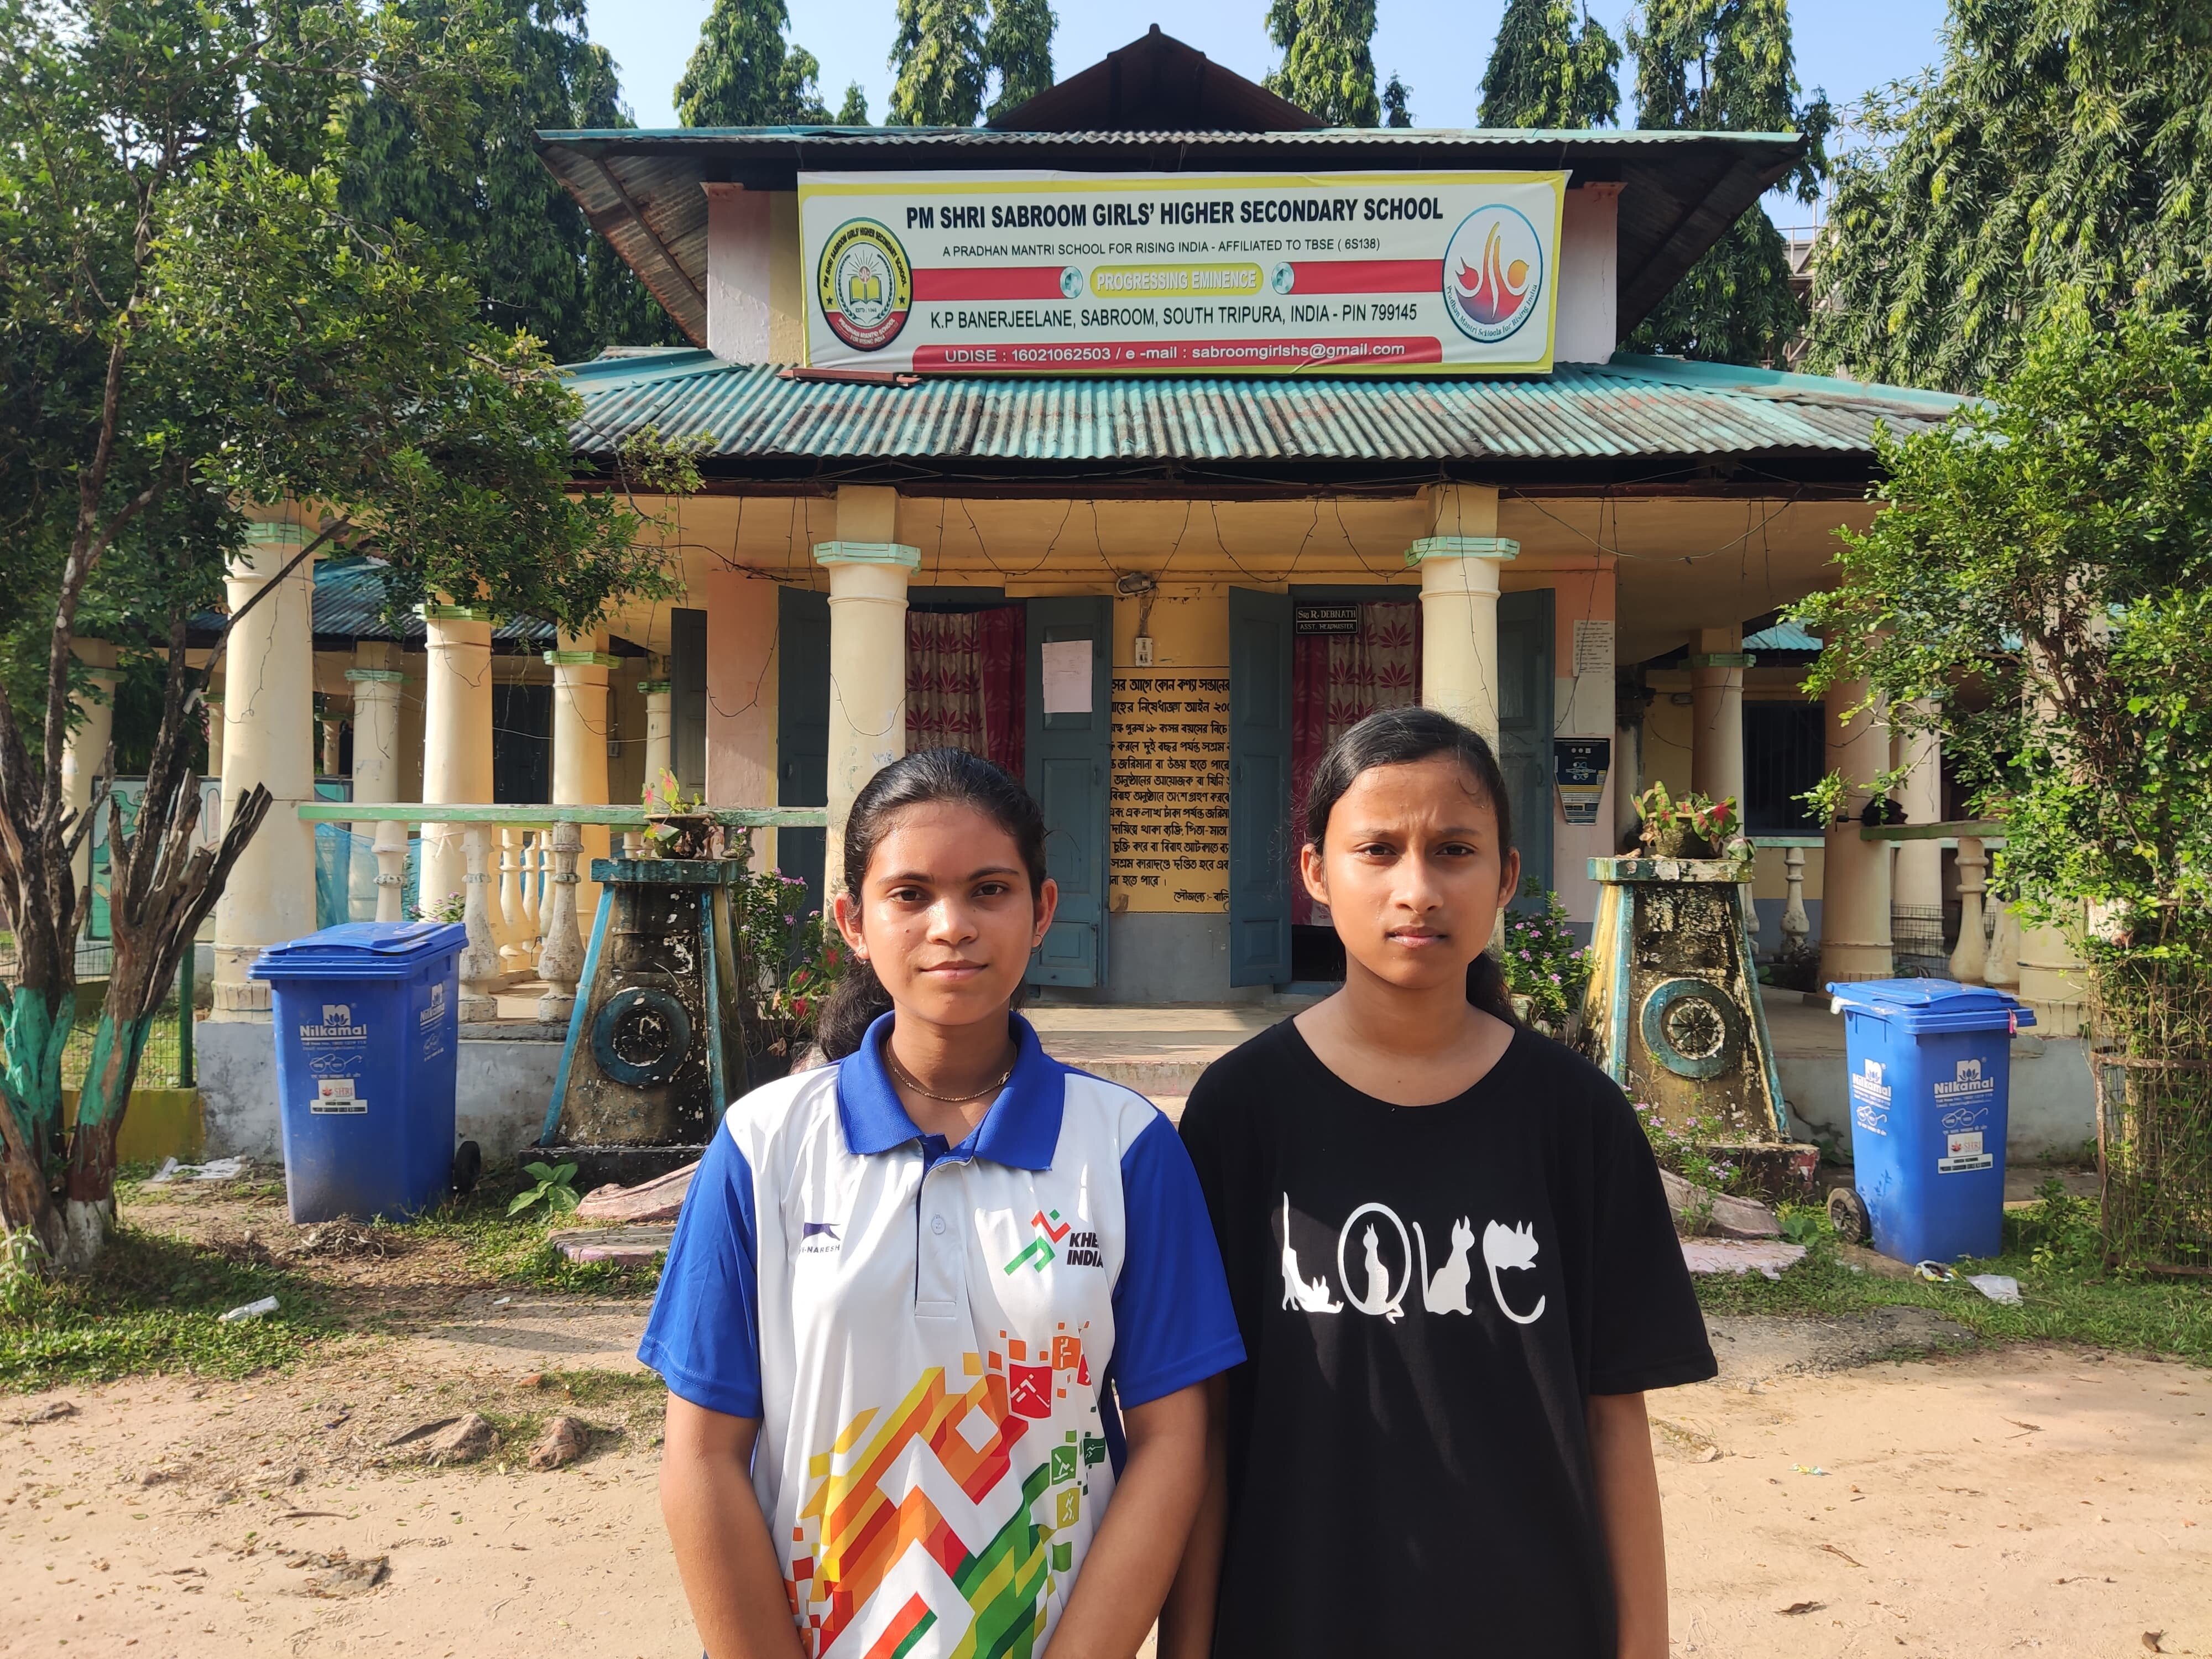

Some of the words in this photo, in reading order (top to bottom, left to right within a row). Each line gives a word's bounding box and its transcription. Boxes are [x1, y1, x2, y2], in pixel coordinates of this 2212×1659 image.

[906, 207, 934, 228] PM
[940, 206, 985, 228] SHRI
[992, 204, 1086, 227] SABROOM
[1161, 201, 1234, 225] HIGHER
[1240, 199, 1358, 223] SECONDARY
[1364, 197, 1443, 221] SCHOOL
[943, 247, 950, 257] A
[953, 245, 1008, 257] PRADHAN
[1011, 244, 1054, 255] MANTRI
[1058, 243, 1105, 255] SCHOOL
[1109, 243, 1133, 254] FOR
[1136, 242, 1175, 253] RISING
[1178, 241, 1208, 253] INDIA
[1218, 239, 1282, 252] AFFILIATED
[1286, 239, 1301, 250] TO
[1305, 238, 1334, 250] TBSE
[896, 257, 907, 288] SCHOOL
[1097, 272, 1188, 291] PROGRESSING
[1191, 270, 1257, 289] EMINENCE
[931, 311, 954, 328] K.P
[958, 310, 1076, 329] BANERJEELANE,
[1081, 308, 1158, 327] SABROOM,
[1164, 307, 1213, 325] SOUTH
[1218, 305, 1285, 325] TRIPURA,
[1291, 305, 1329, 322] INDIA
[1342, 304, 1366, 321] PIN
[1371, 303, 1417, 321] 799145
[1459, 315, 1478, 335] Mantri
[1502, 323, 1511, 333] for
[1511, 306, 1528, 326] Rising
[945, 349, 997, 362] UDISE
[1011, 348, 1110, 361] 16021062503
[1192, 343, 1405, 360] sabroomgirlshs@gmail.com
[1321, 610, 1355, 618] DEBNATH
[1130, 679, 1153, 693] আগে
[1155, 679, 1175, 693] কোন
[1183, 698, 1210, 713] আইন
[1146, 724, 1157, 733] ১৮
[1181, 724, 1208, 735] বয়সের
[1210, 721, 1228, 735] নিচে
[1117, 742, 1140, 753] করলে
[1142, 737, 1156, 755] দুই
[1158, 742, 1178, 753] বছর
[1118, 755, 1152, 770] জরিমানা
[1155, 759, 1164, 769] বা
[1167, 755, 1187, 770] উভয়
[1190, 760, 1208, 771] হতে
[1114, 772, 1152, 787] অনুষ্ঠানের
[1154, 776, 1193, 787] আয়োজক
[1195, 776, 1204, 786] বা
[1207, 773, 1224, 787] যিনি
[1110, 787, 1132, 801] বিবাহ
[1133, 788, 1165, 802] অনুষ্ঠানে
[1163, 805, 1182, 818] টাকা
[1141, 825, 1162, 835] থাকা
[1112, 837, 1130, 853] চুক্তি
[1133, 842, 1149, 852] করে
[1150, 842, 1159, 852] বা
[1160, 839, 1182, 852] বিবাহ
[1199, 860, 1216, 871] হবে
[1121, 875, 1138, 887] হতে
[1141, 875, 1160, 887] পারে
[300, 1024, 367, 1036] Nilkamal
[1853, 1073, 1891, 1097] Nilkamal
[1934, 1077, 1994, 1094] Nilkamal
[1067, 1250, 1103, 1268] INDIA
